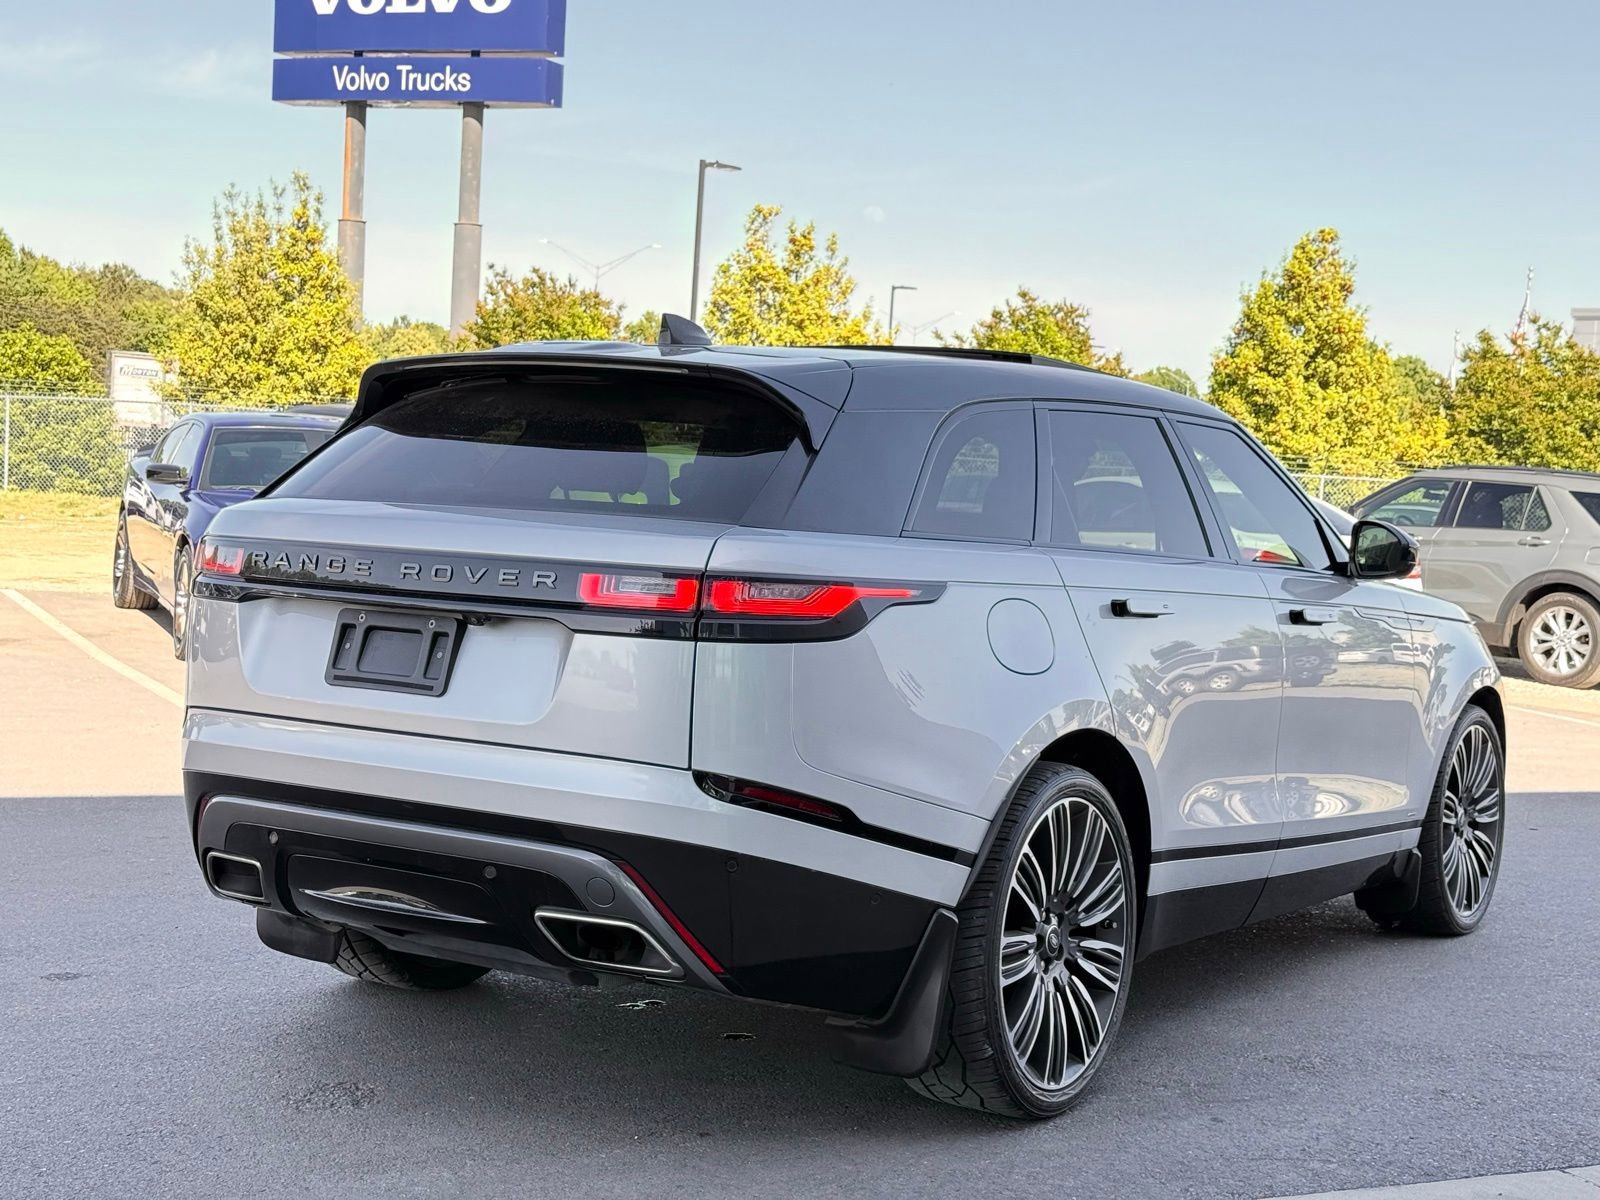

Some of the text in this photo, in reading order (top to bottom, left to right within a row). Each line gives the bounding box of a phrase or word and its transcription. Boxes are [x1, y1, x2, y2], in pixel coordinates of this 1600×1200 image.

[332, 64, 472, 92] Volvo Trucks
[251, 550, 558, 589] RANGE ROVER
